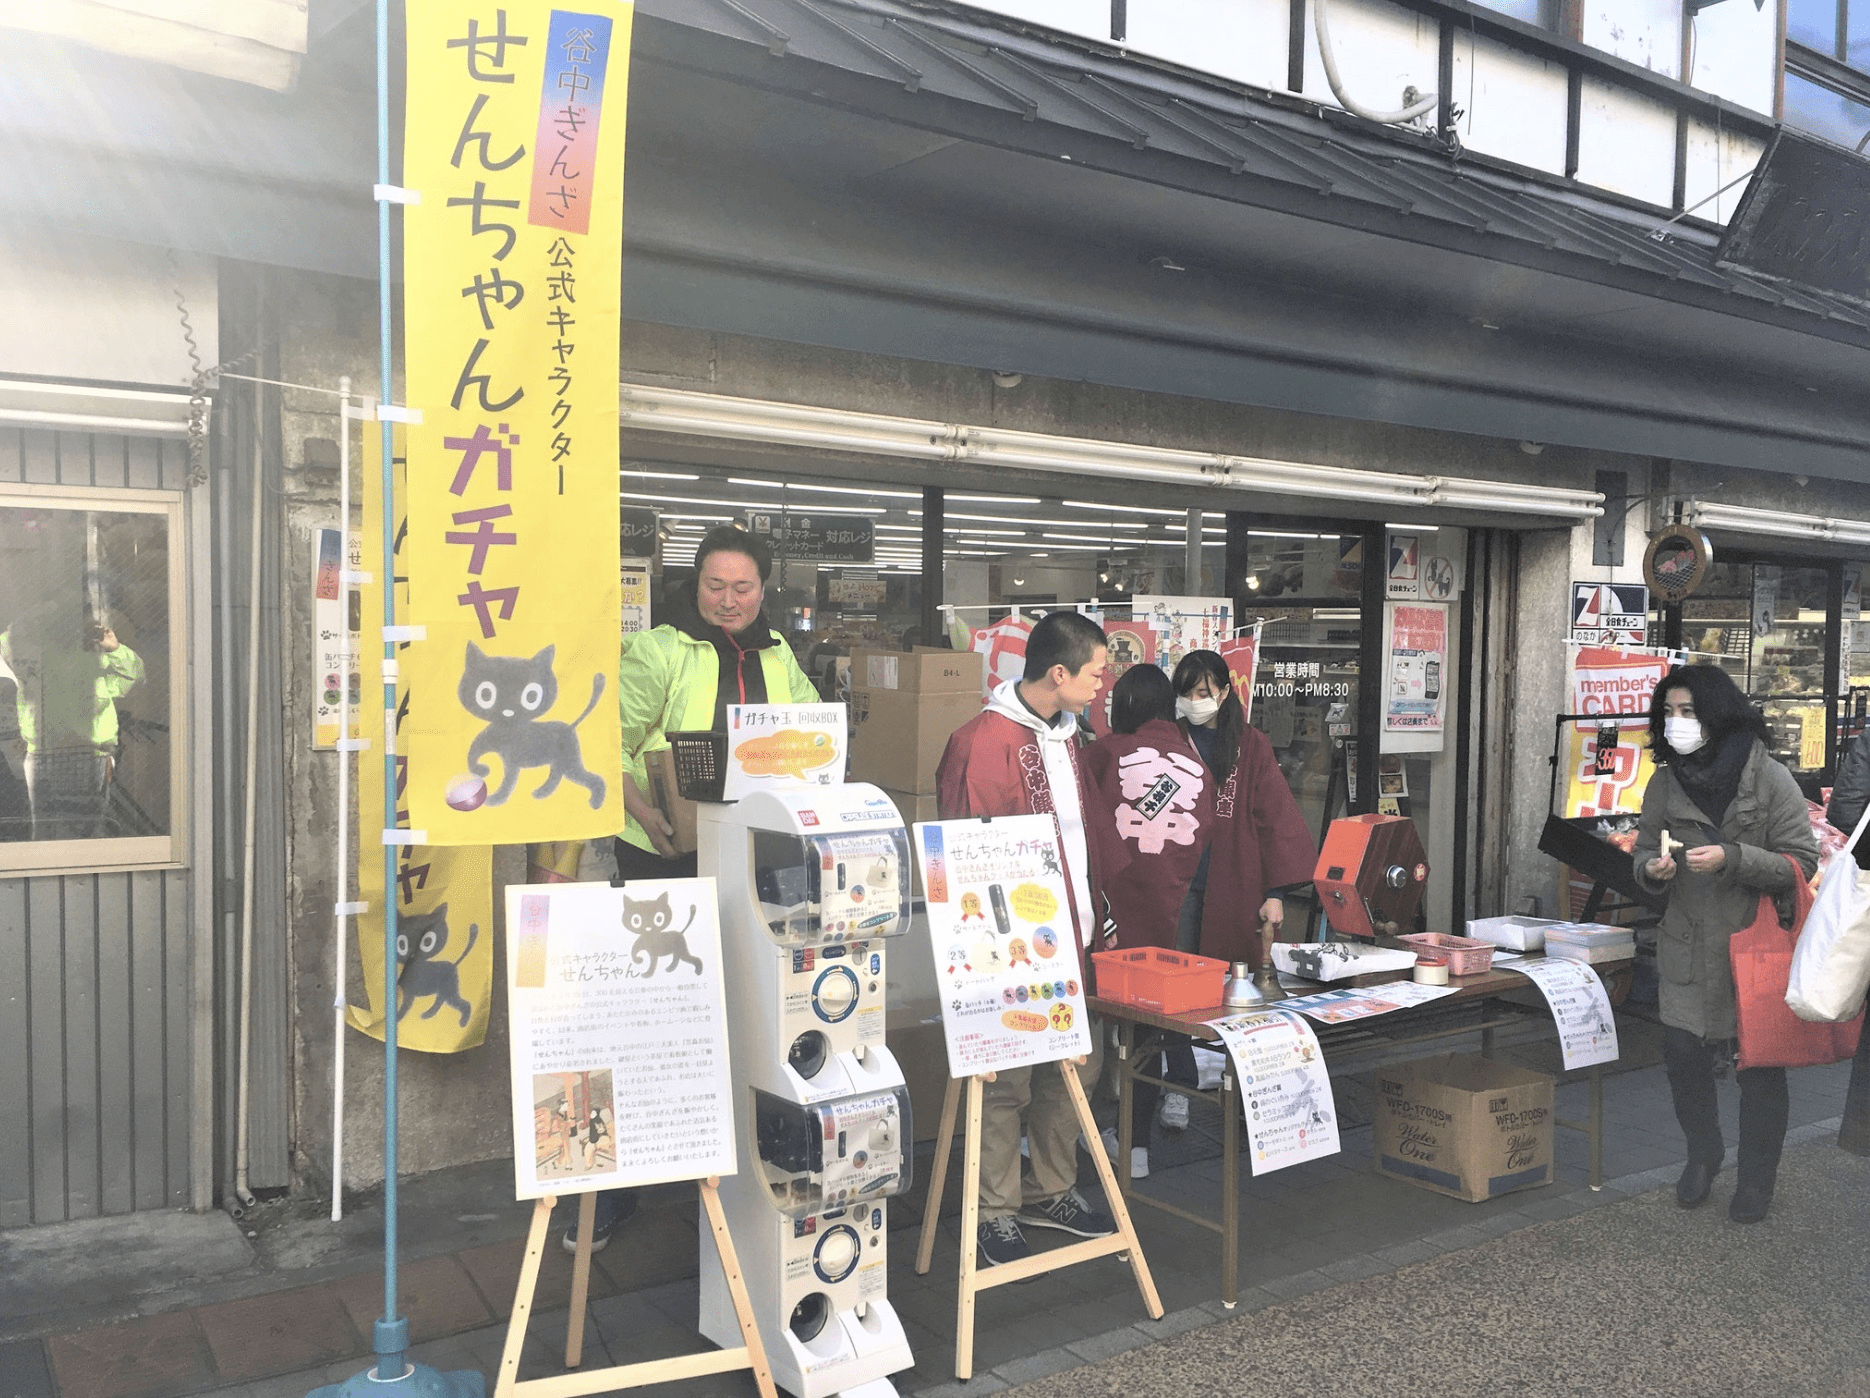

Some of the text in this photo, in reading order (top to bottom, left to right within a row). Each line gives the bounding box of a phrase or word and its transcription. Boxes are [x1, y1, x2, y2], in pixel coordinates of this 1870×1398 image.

[546, 27, 596, 219] 谷中ぎんざ
[444, 8, 528, 640] せんちゃんガチャ
[546, 236, 576, 495] 公式キャラクター
[765, 540, 824, 551] クレットカード
[826, 529, 871, 544] 対応レジ
[1606, 616, 1638, 627] 全日食チェーン
[1576, 631, 1596, 641] のなか
[1274, 662, 1320, 678] 営業時間
[1580, 674, 1658, 693] member's
[1581, 694, 1653, 715] CARD
[745, 712, 838, 725] ガチャ玉 回収BOX
[950, 839, 1053, 861] せんちゃんガチャ
[560, 963, 640, 982] せんちゃん
[1399, 1138, 1436, 1162] One
[1507, 1150, 1536, 1170] One
